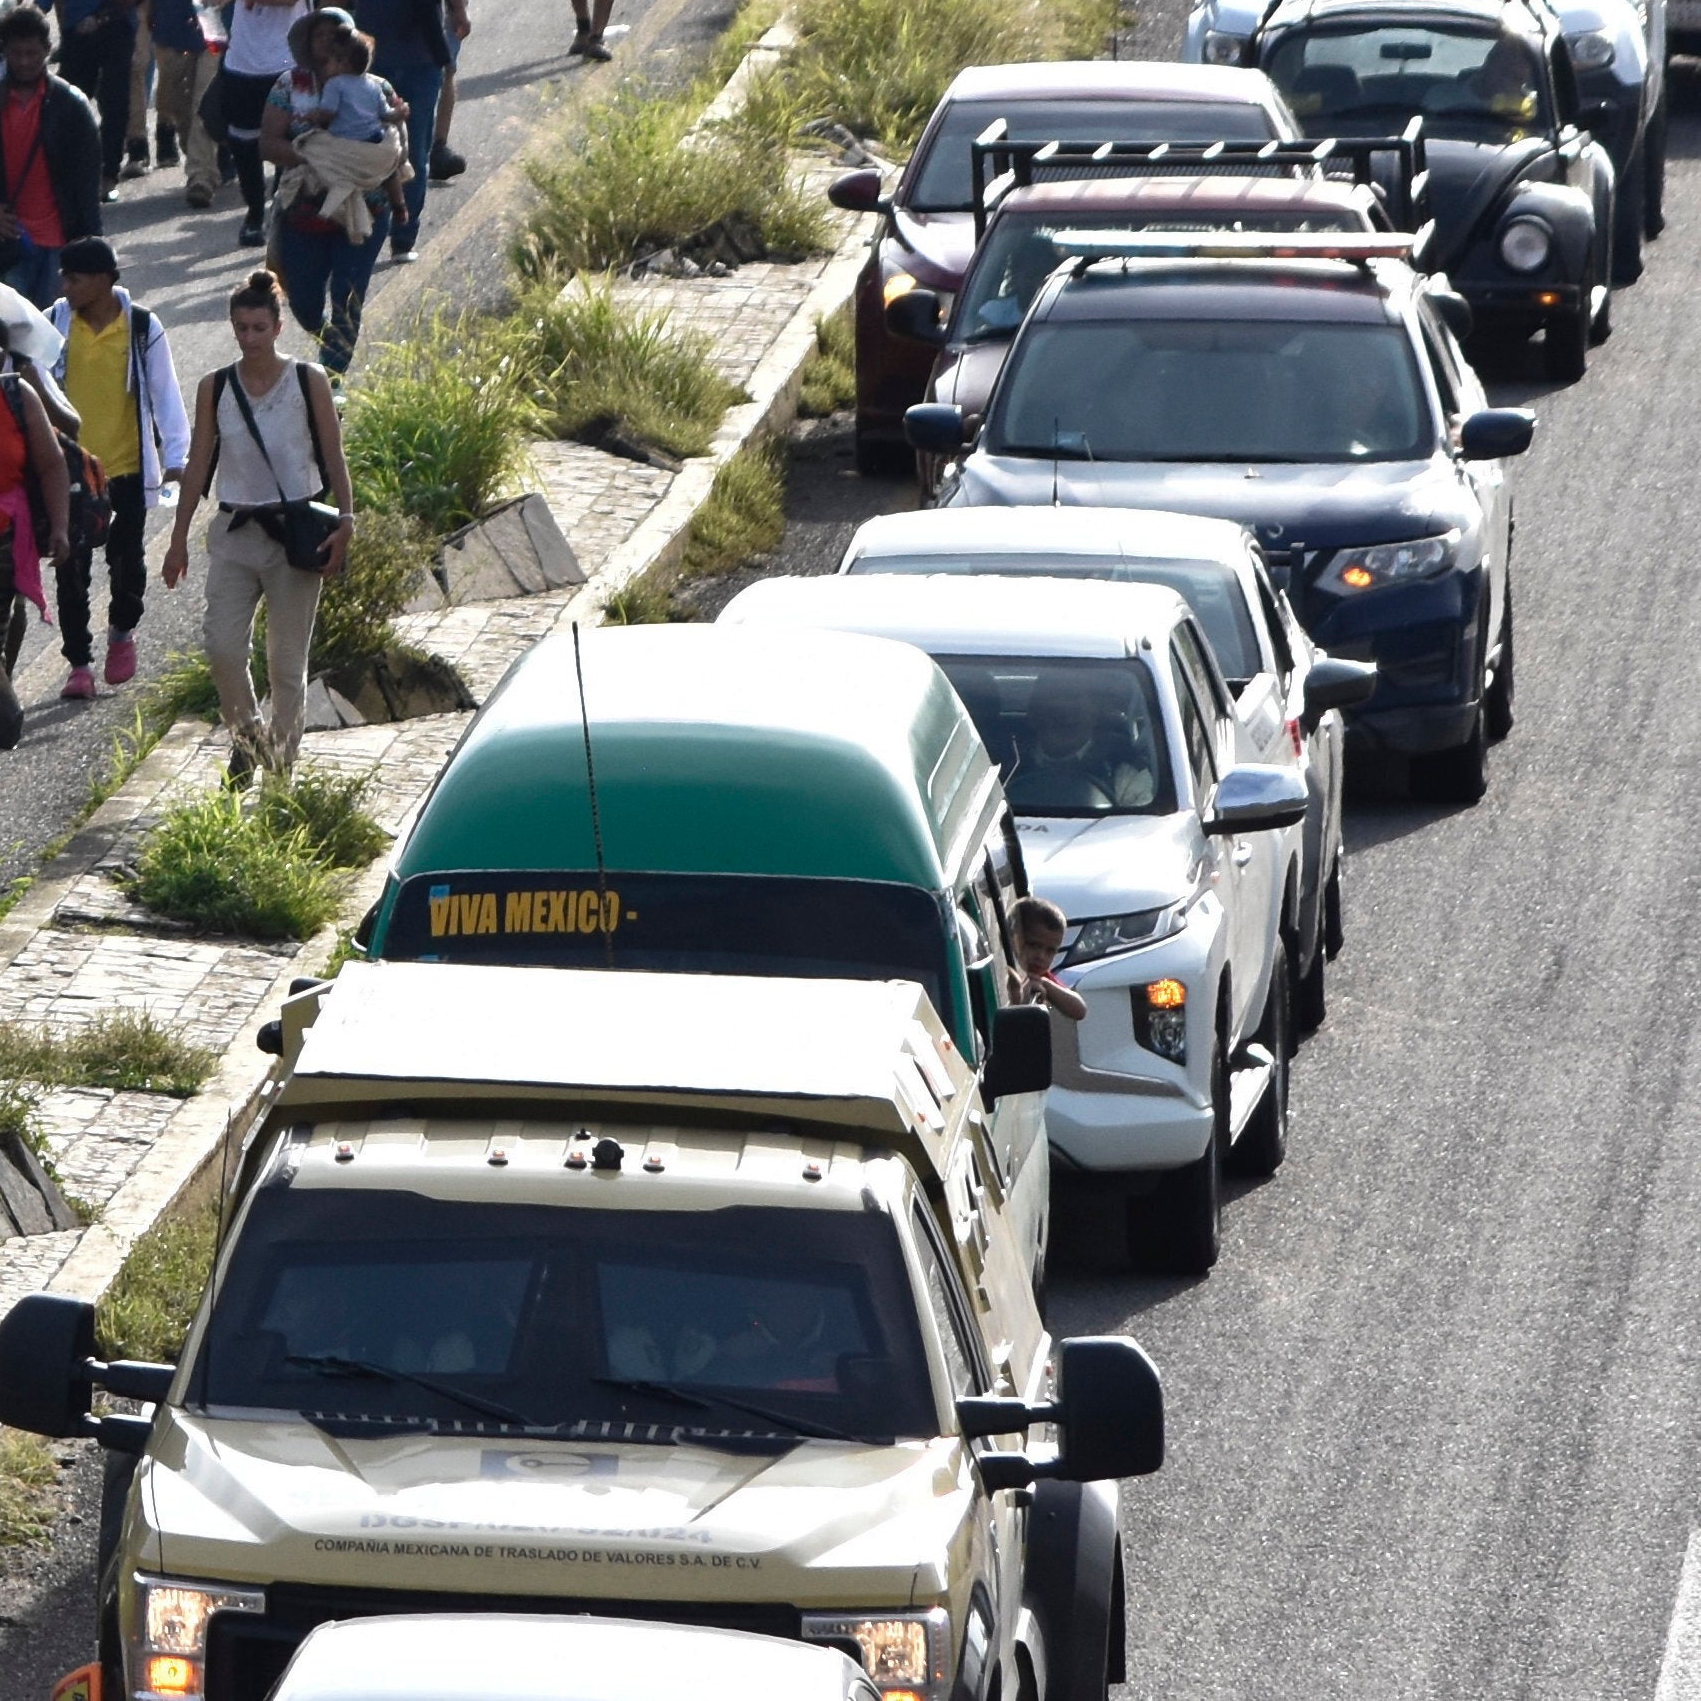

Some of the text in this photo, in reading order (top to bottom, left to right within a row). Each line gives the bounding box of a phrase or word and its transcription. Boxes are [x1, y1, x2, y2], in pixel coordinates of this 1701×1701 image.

[430, 892, 497, 937] VIVA
[504, 890, 620, 934] MEXICO
[394, 1542, 470, 1558] MEXICANA
[474, 1545, 494, 1558] DE
[498, 1546, 578, 1562] TRASLADO
[582, 1549, 602, 1563] DE
[606, 1551, 675, 1566] VALORES
[679, 1553, 707, 1567] S.A.
[711, 1555, 733, 1569] DE
[735, 1556, 762, 1570] C.V.
